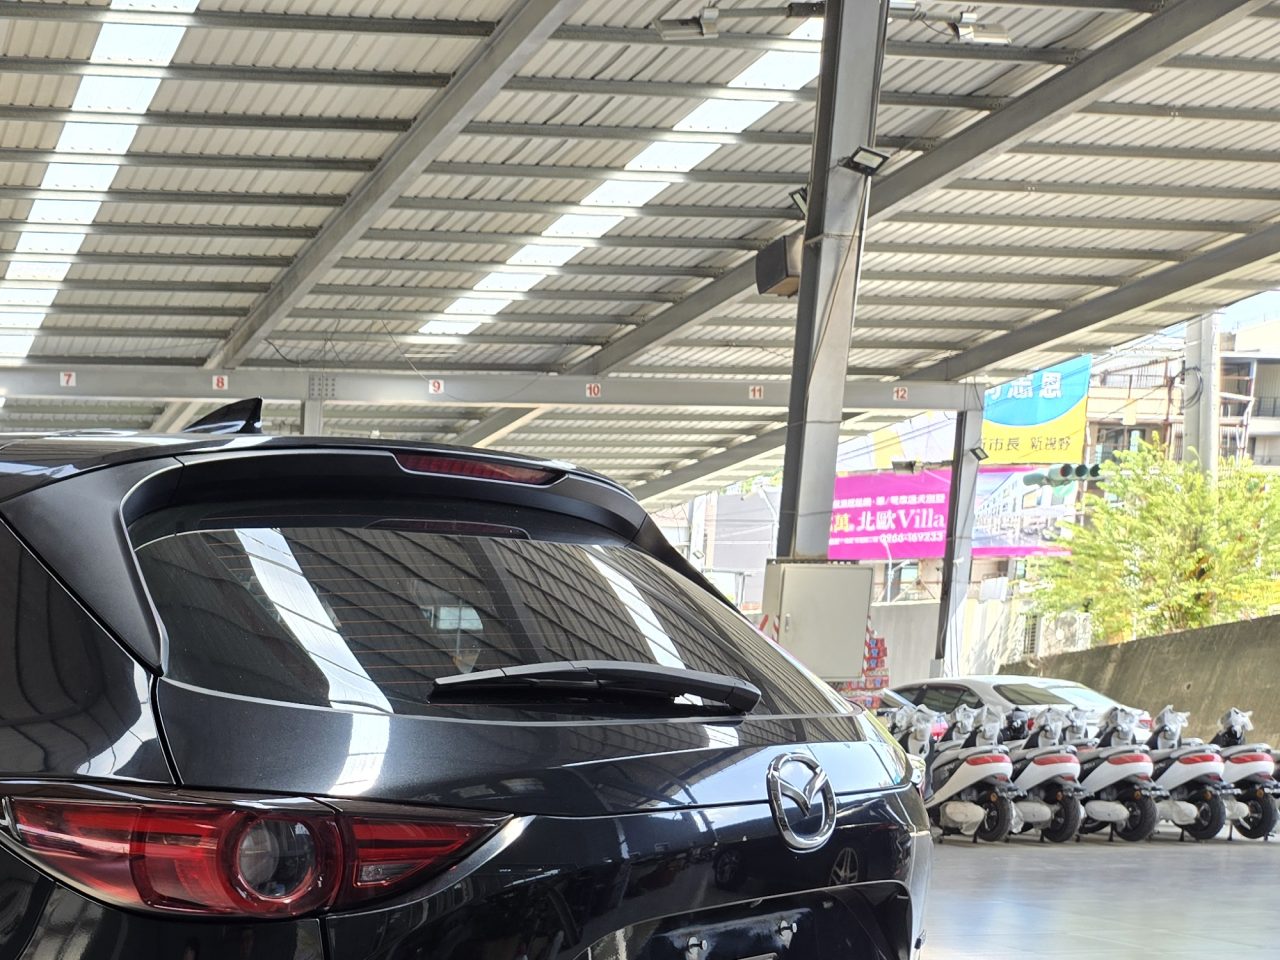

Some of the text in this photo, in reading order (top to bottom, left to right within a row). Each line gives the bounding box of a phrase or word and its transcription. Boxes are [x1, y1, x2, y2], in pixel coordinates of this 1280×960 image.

[64, 373, 73, 385] 7
[216, 376, 225, 389] 8
[432, 381, 441, 392] 9
[587, 384, 600, 396] 10
[985, 371, 1062, 400] 志恩
[751, 386, 762, 398] 11
[895, 388, 907, 399] 12
[983, 437, 1020, 452] 市長
